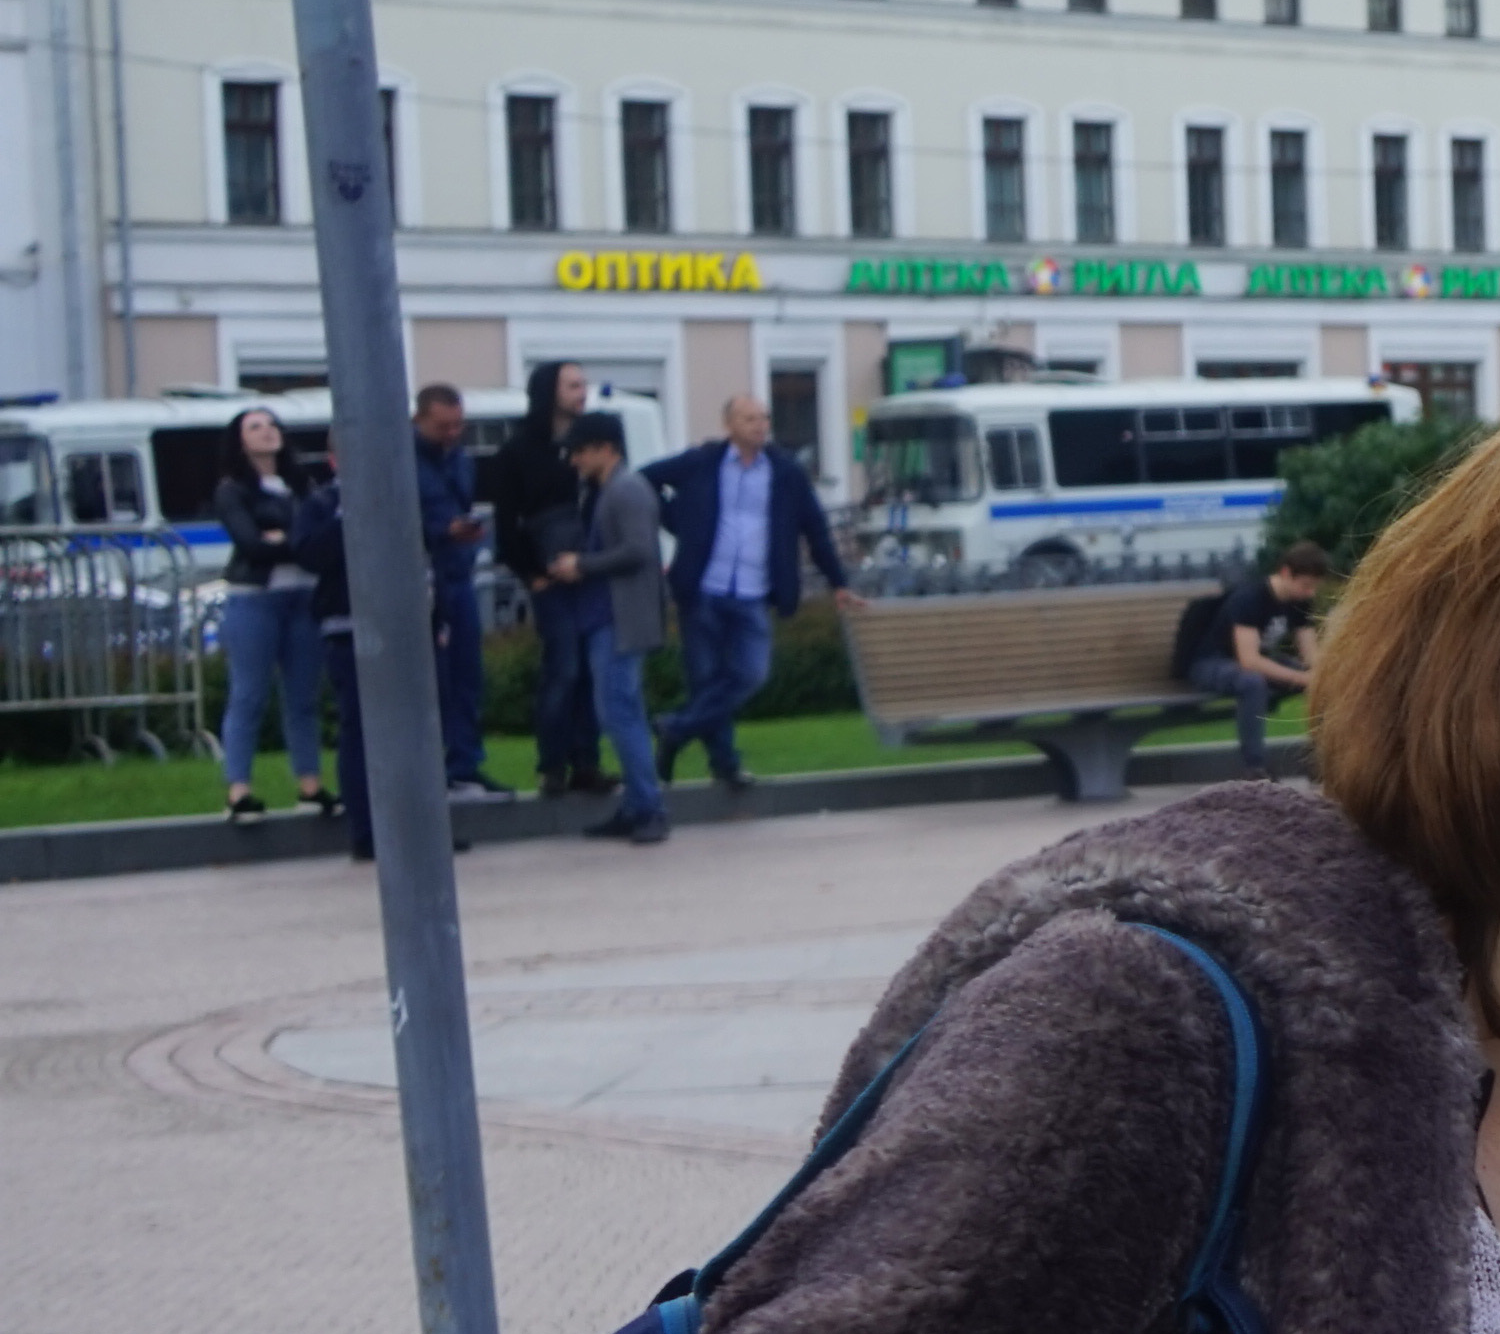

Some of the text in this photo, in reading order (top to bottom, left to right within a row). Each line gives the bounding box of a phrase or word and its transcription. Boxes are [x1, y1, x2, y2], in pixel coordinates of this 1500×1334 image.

[557, 251, 762, 292] ОПТИКА
[846, 257, 1202, 296] АПТЕКА РИГЛА
[1247, 263, 1392, 299] АПТЕКА
